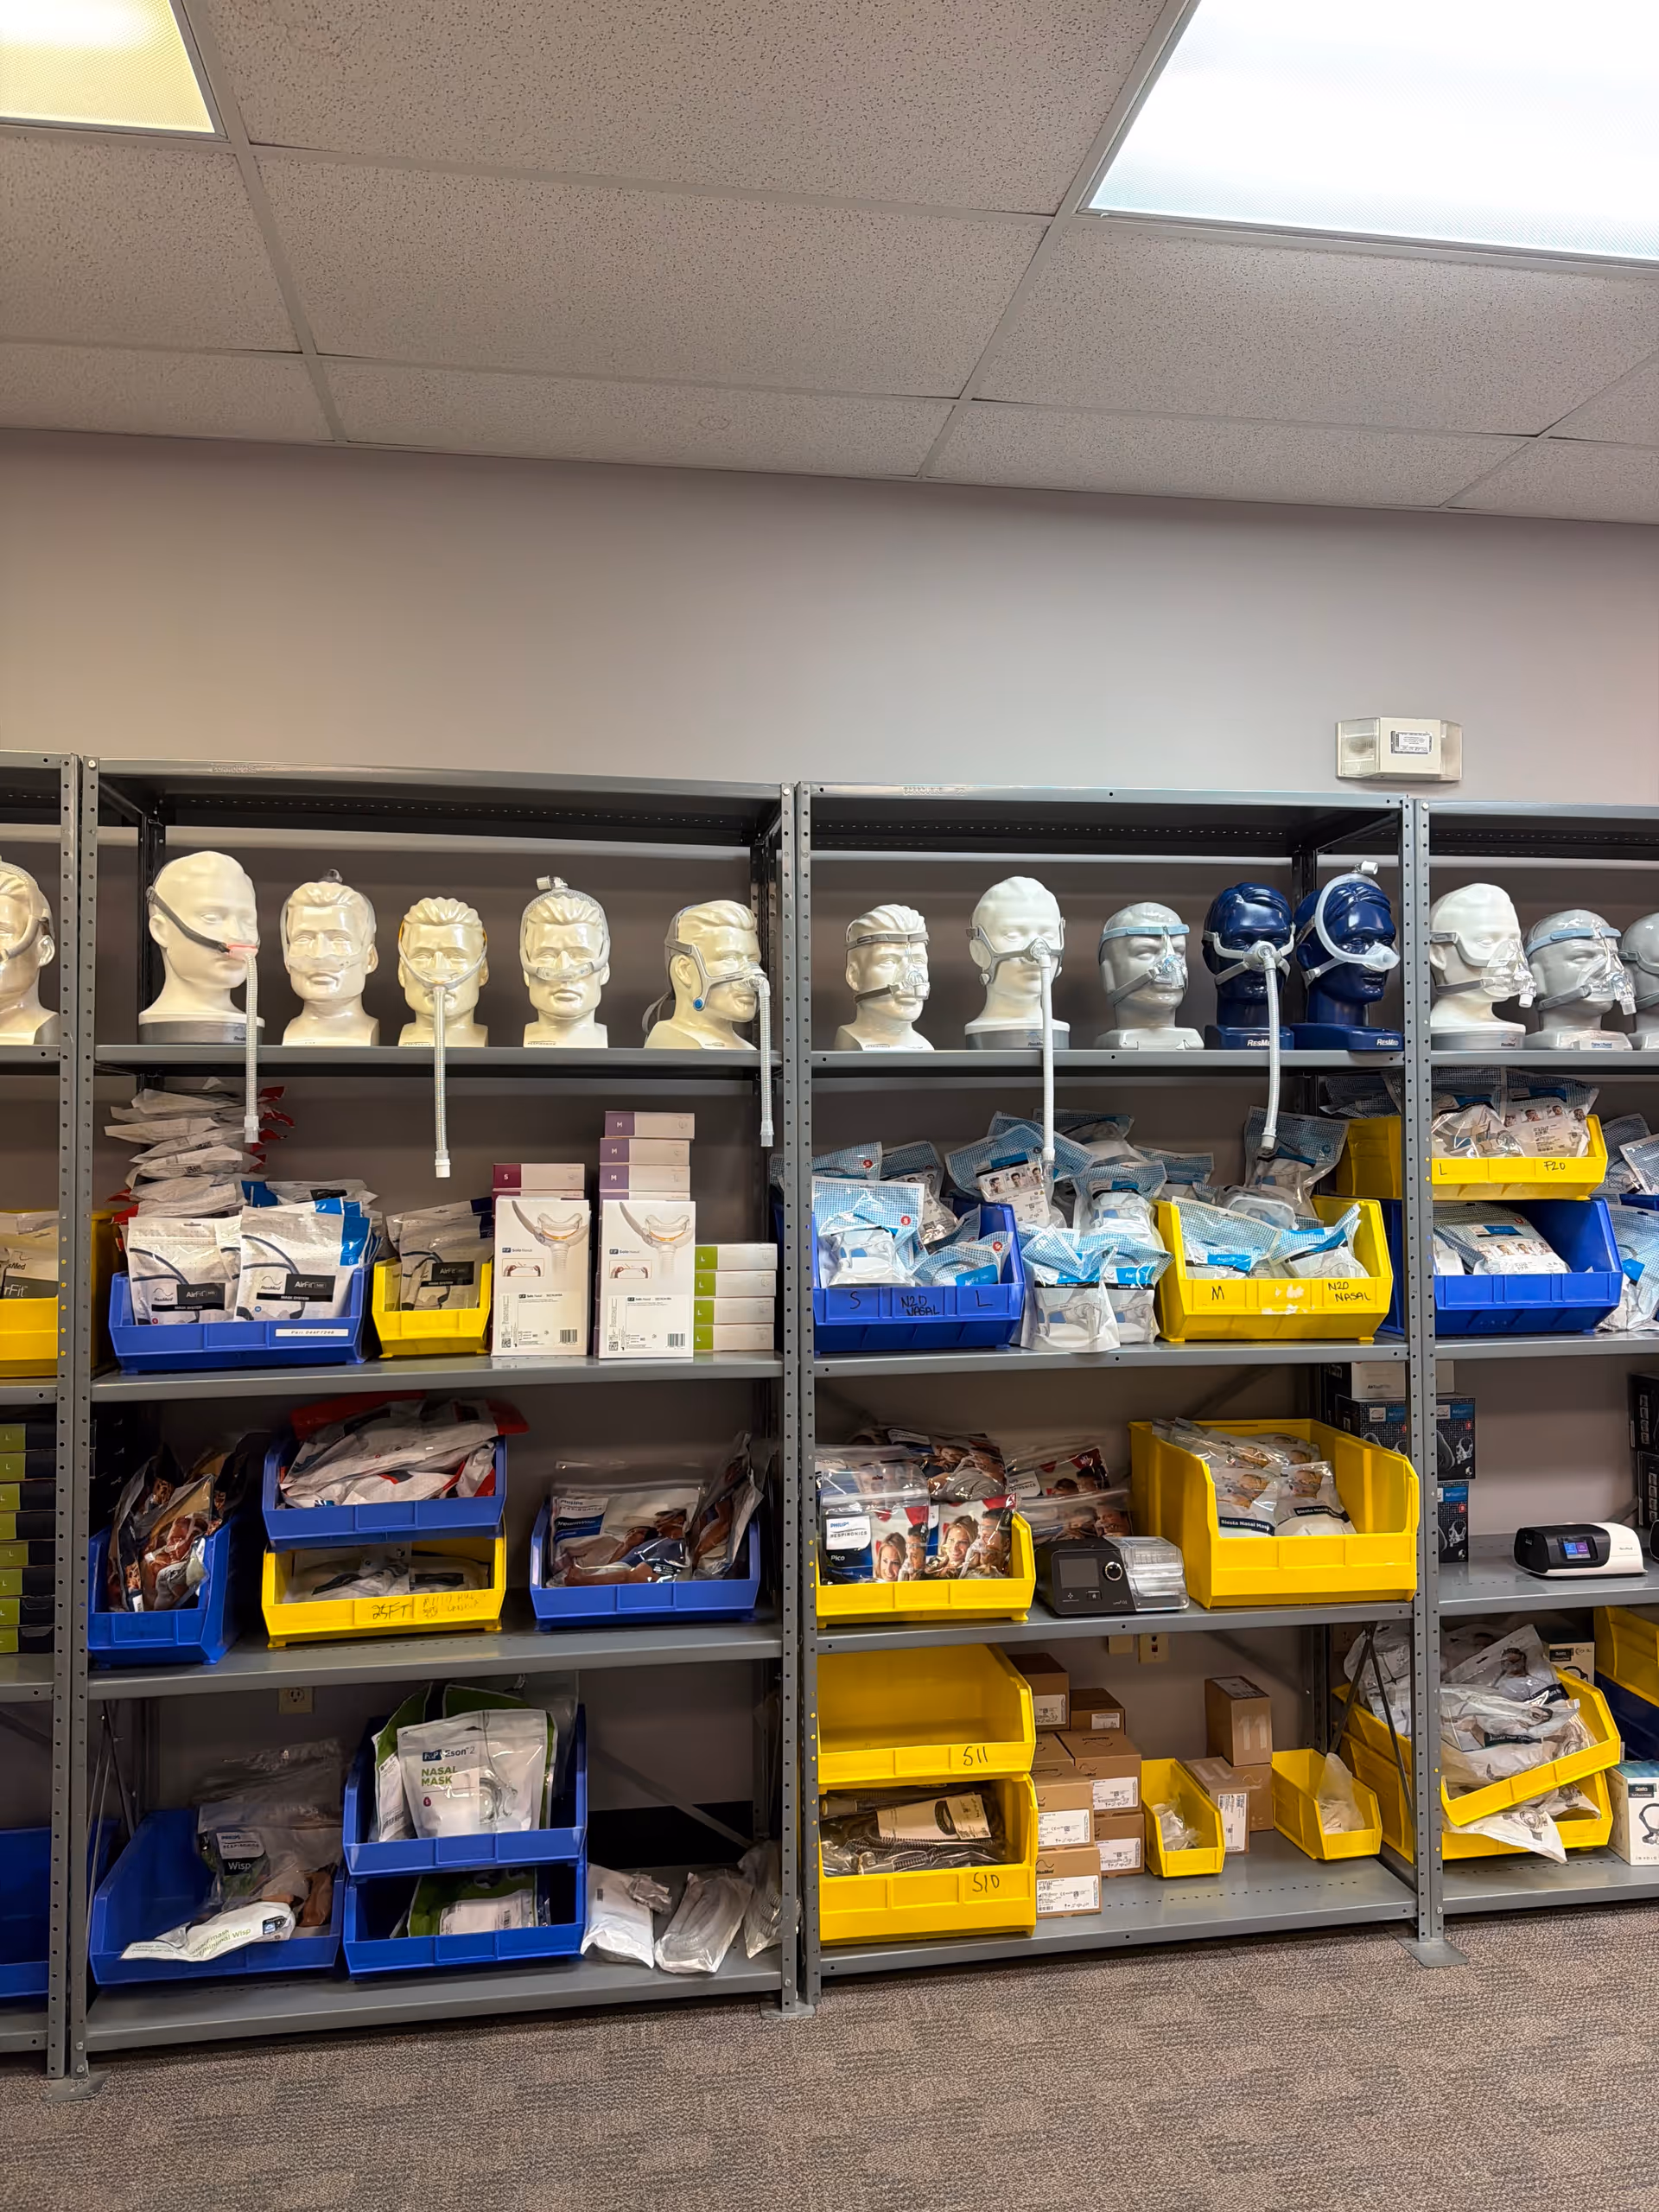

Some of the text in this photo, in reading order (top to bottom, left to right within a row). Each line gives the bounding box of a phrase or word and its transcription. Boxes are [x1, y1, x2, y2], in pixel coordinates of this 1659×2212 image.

[1439, 1163, 1447, 1176] L
[976, 1290, 994, 1307] L
[1211, 1285, 1225, 1300] M
[1334, 1290, 1372, 1302] NASAL
[849, 1290, 861, 1310] S
[469, 1746, 475, 1755] 2
[421, 1775, 453, 1787] MASK
[227, 1861, 251, 1873] Wisp
[232, 1928, 251, 1939] Wisp
